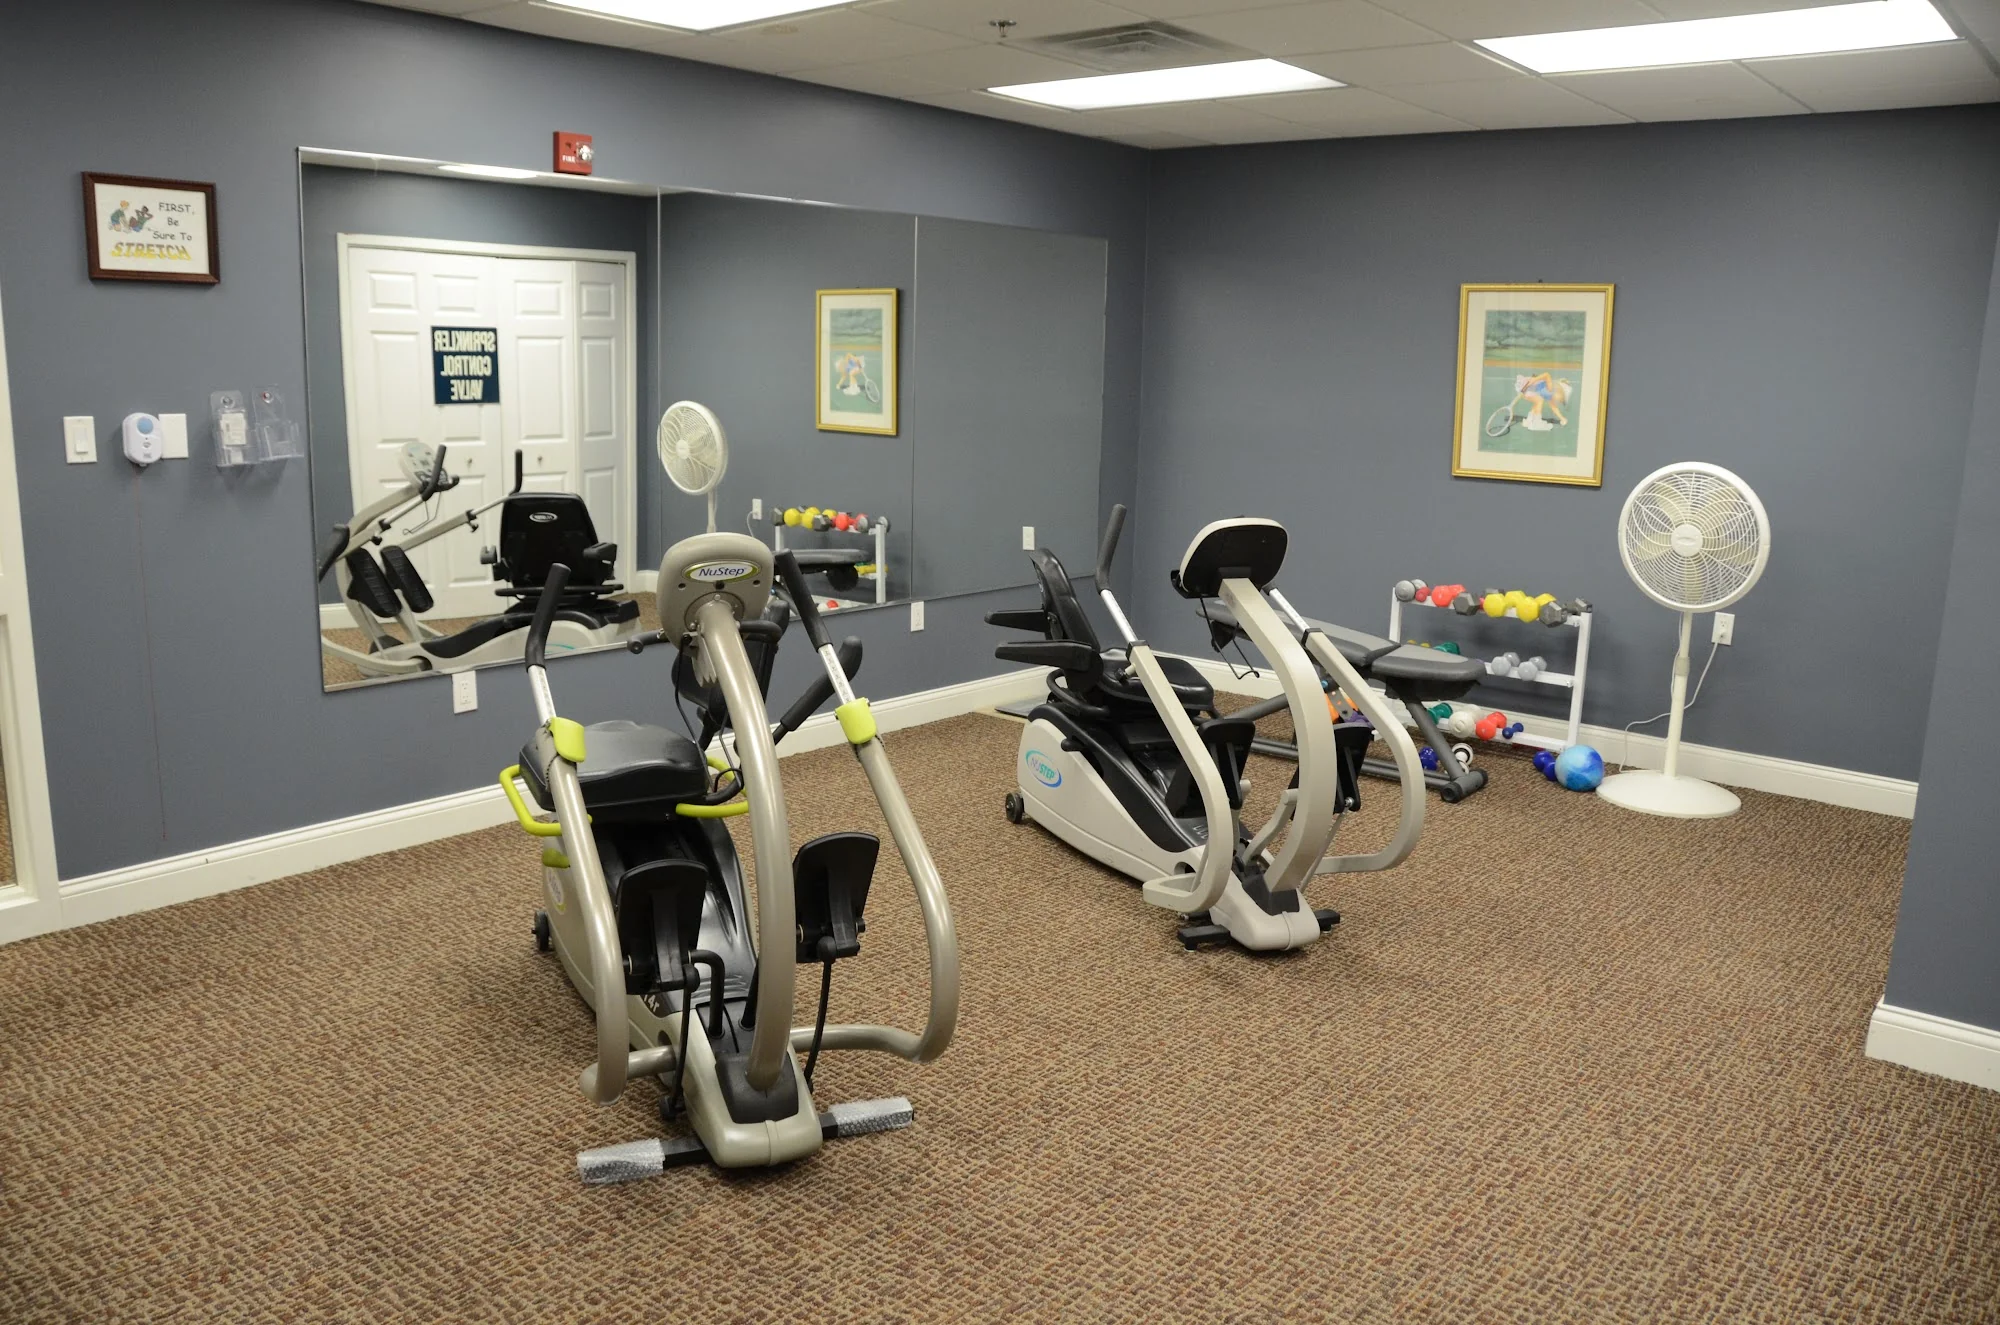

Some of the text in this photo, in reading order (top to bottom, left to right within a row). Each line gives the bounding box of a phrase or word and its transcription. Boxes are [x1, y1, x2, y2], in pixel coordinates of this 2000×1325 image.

[158, 202, 195, 215] FIRST,
[167, 217, 179, 226] Be
[152, 230, 193, 241] Sure To
[111, 242, 192, 261] STRETCH
[698, 566, 745, 577] NuStep
